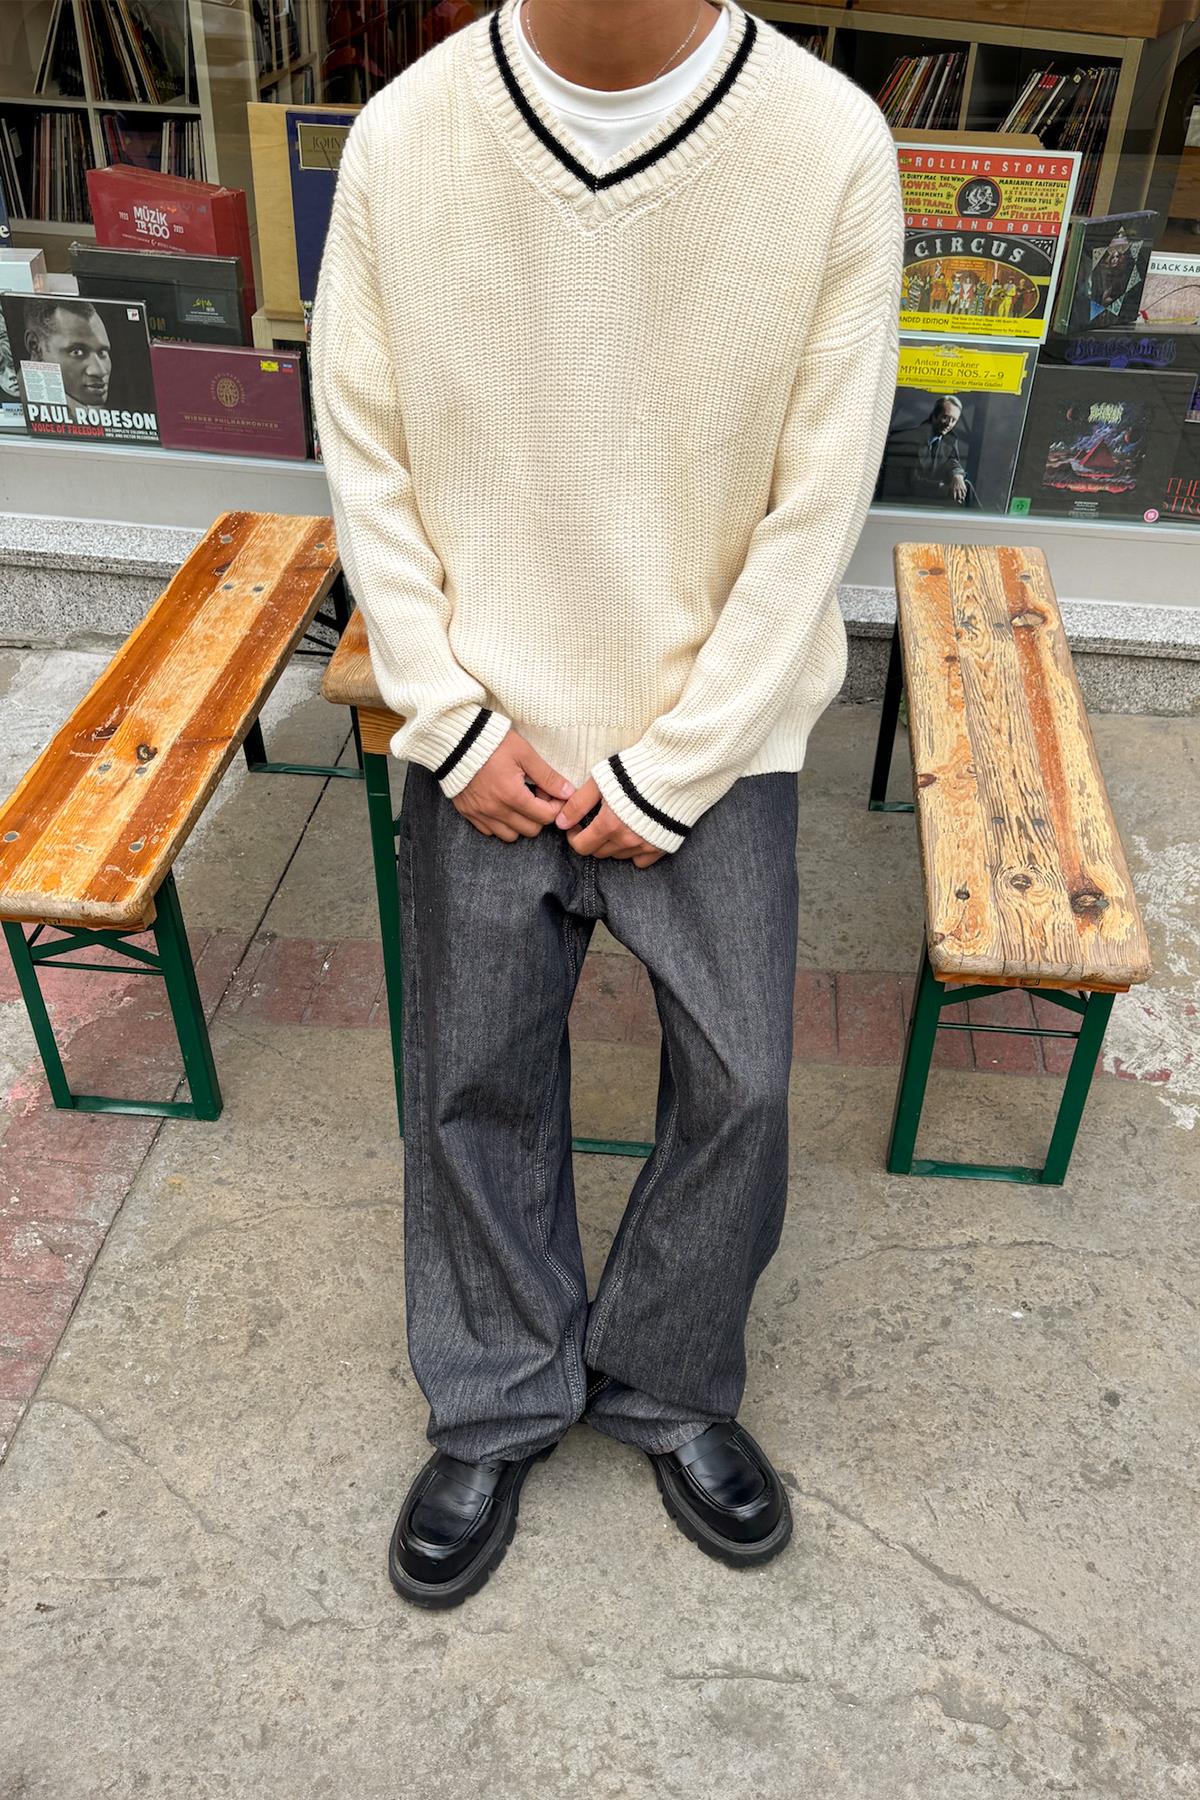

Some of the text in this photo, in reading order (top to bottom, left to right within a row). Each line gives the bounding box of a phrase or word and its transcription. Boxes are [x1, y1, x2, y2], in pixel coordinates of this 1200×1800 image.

[915, 156, 991, 171] ROLLING
[1002, 157, 1068, 176] STONES
[999, 179, 1033, 187] MARIANNE
[956, 218, 993, 230] AND
[1007, 220, 1057, 234] ROLL
[914, 236, 1025, 263] CIRCUS
[1150, 262, 1181, 272] BLACK
[922, 317, 949, 325] EDITION
[915, 358, 980, 369] Anton Bruckner
[27, 403, 73, 424] PAUL
[75, 406, 157, 430] ROBESON
[214, 417, 279, 428] PHILHARMONIKER
[31, 422, 104, 437] VOICE OF FREEDOM
